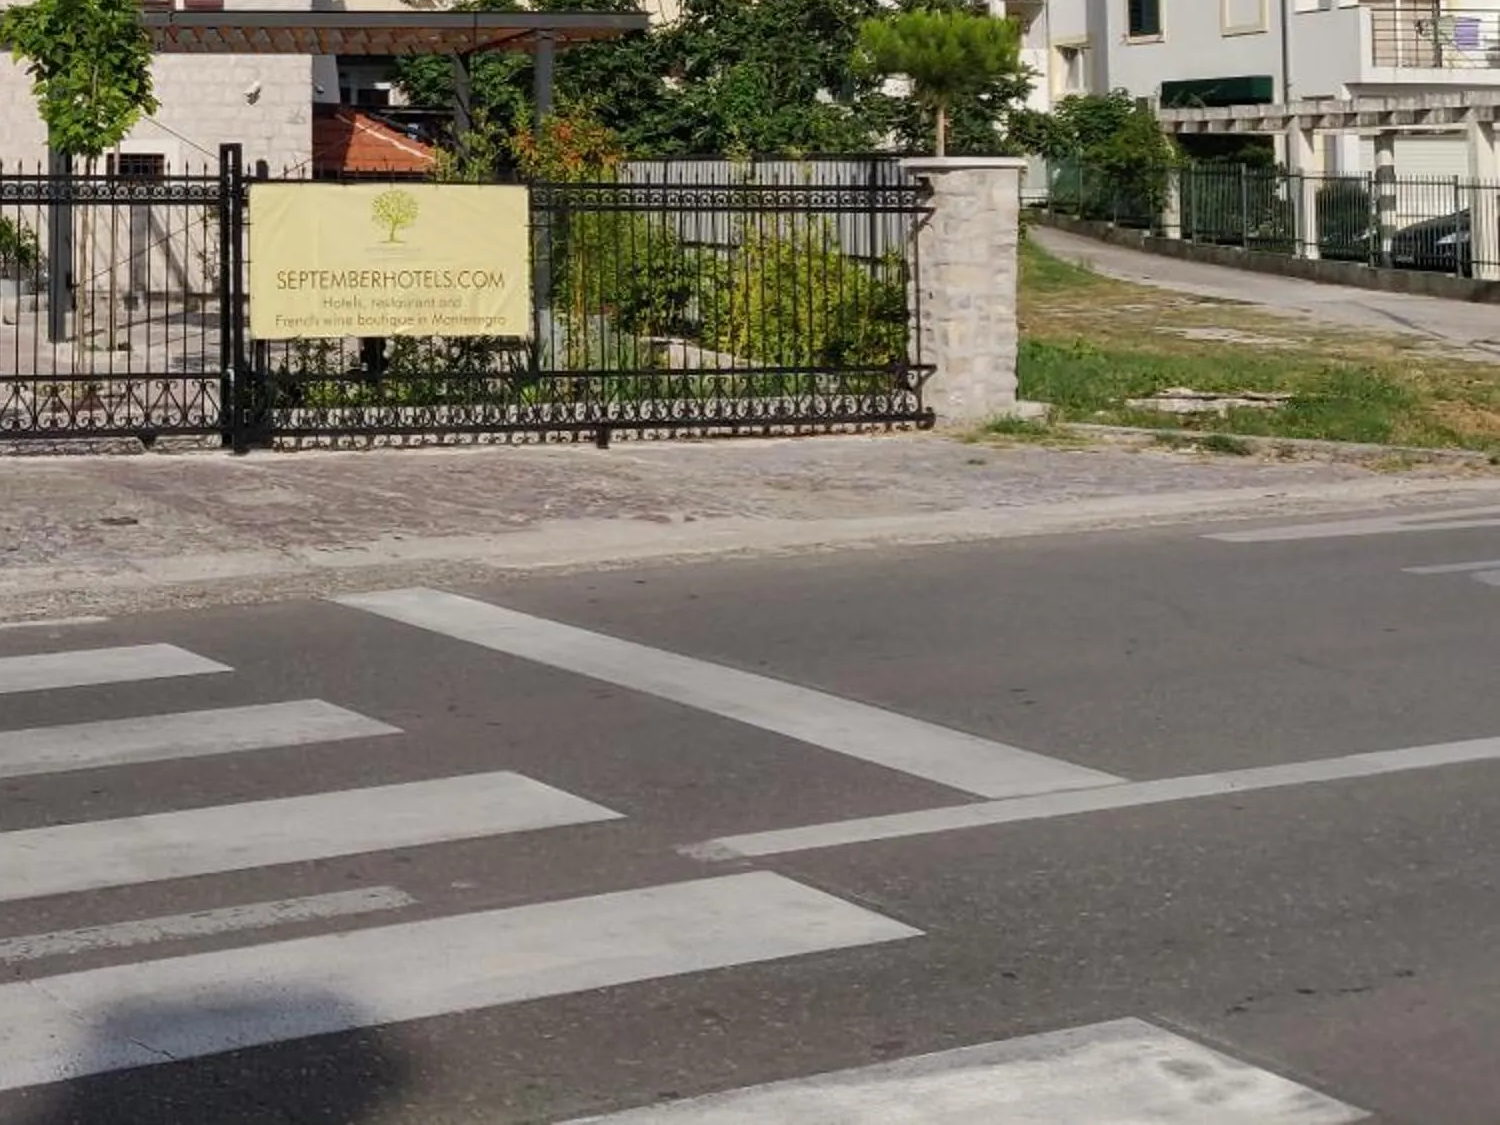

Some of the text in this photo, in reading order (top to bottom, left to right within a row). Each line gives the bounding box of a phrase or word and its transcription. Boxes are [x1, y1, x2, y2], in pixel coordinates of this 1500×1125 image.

[276, 269, 506, 290] SEPTEMBERHOTELS.COM
[371, 296, 435, 309] restaurant
[438, 296, 463, 309] and
[275, 313, 320, 327] French
[323, 315, 354, 327] wine
[357, 312, 415, 328] boutique
[430, 312, 507, 328] Montenegro
